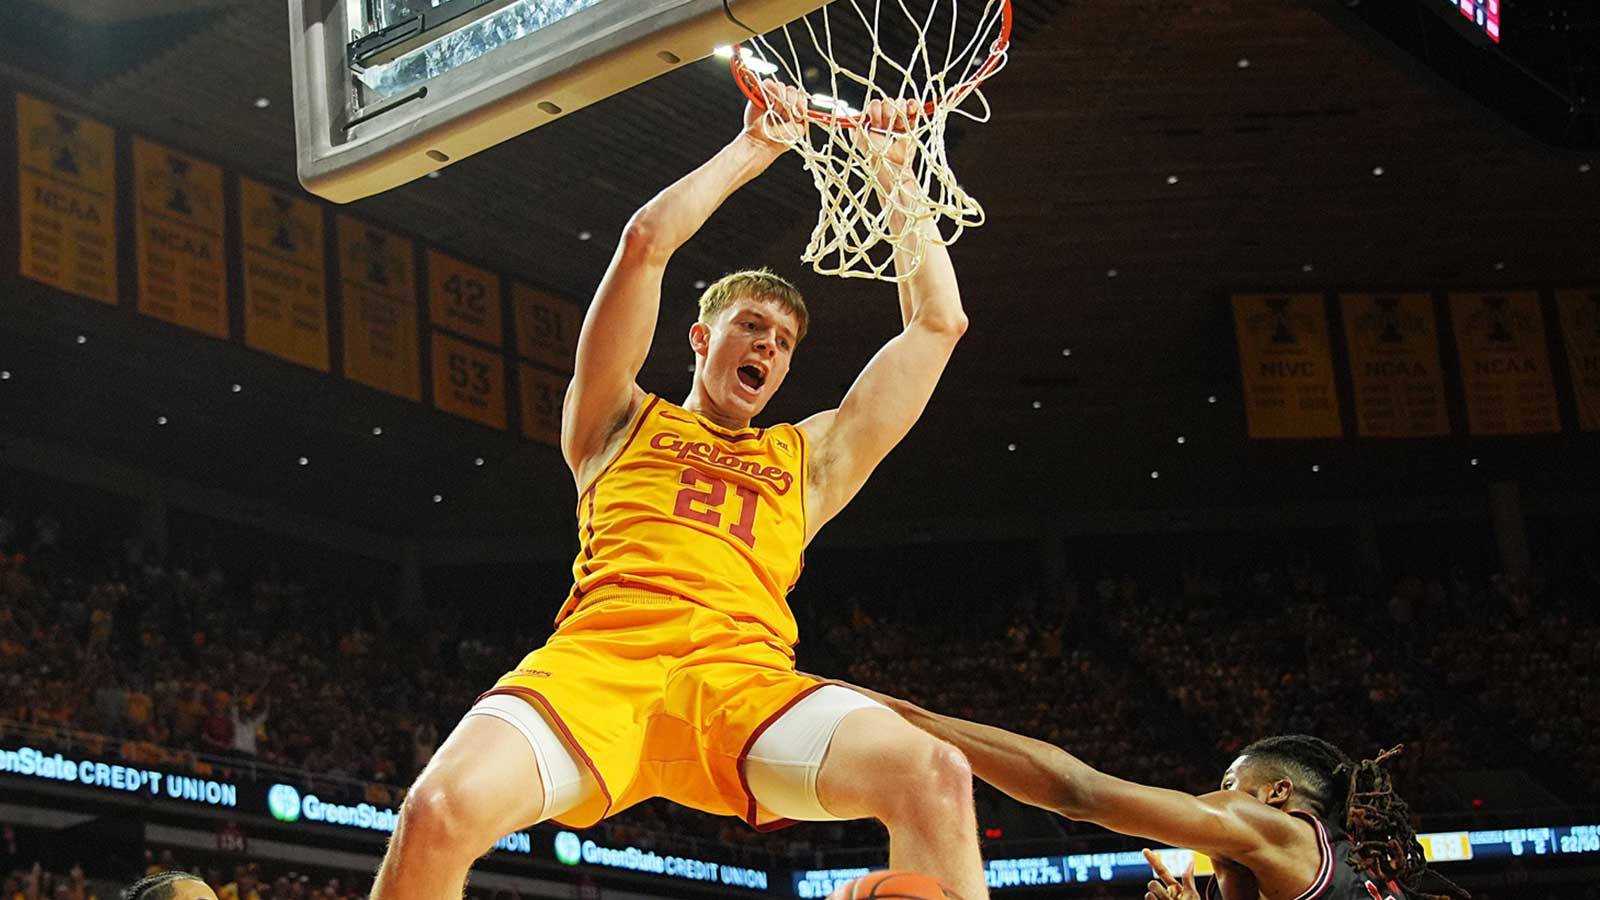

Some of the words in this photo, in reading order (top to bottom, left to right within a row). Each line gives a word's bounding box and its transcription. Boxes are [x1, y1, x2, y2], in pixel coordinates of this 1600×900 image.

[33, 186, 100, 225] NCAA
[149, 227, 212, 260] NCAA
[443, 273, 486, 313] 42
[447, 352, 492, 396] 53
[1365, 360, 1428, 377] NCAA
[650, 432, 793, 496] Cyclones
[673, 467, 760, 549] 21
[166, 773, 237, 807] UNION
[581, 839, 665, 874] GreenState
[665, 857, 719, 884] CREDIT
[721, 866, 768, 890] UNION
